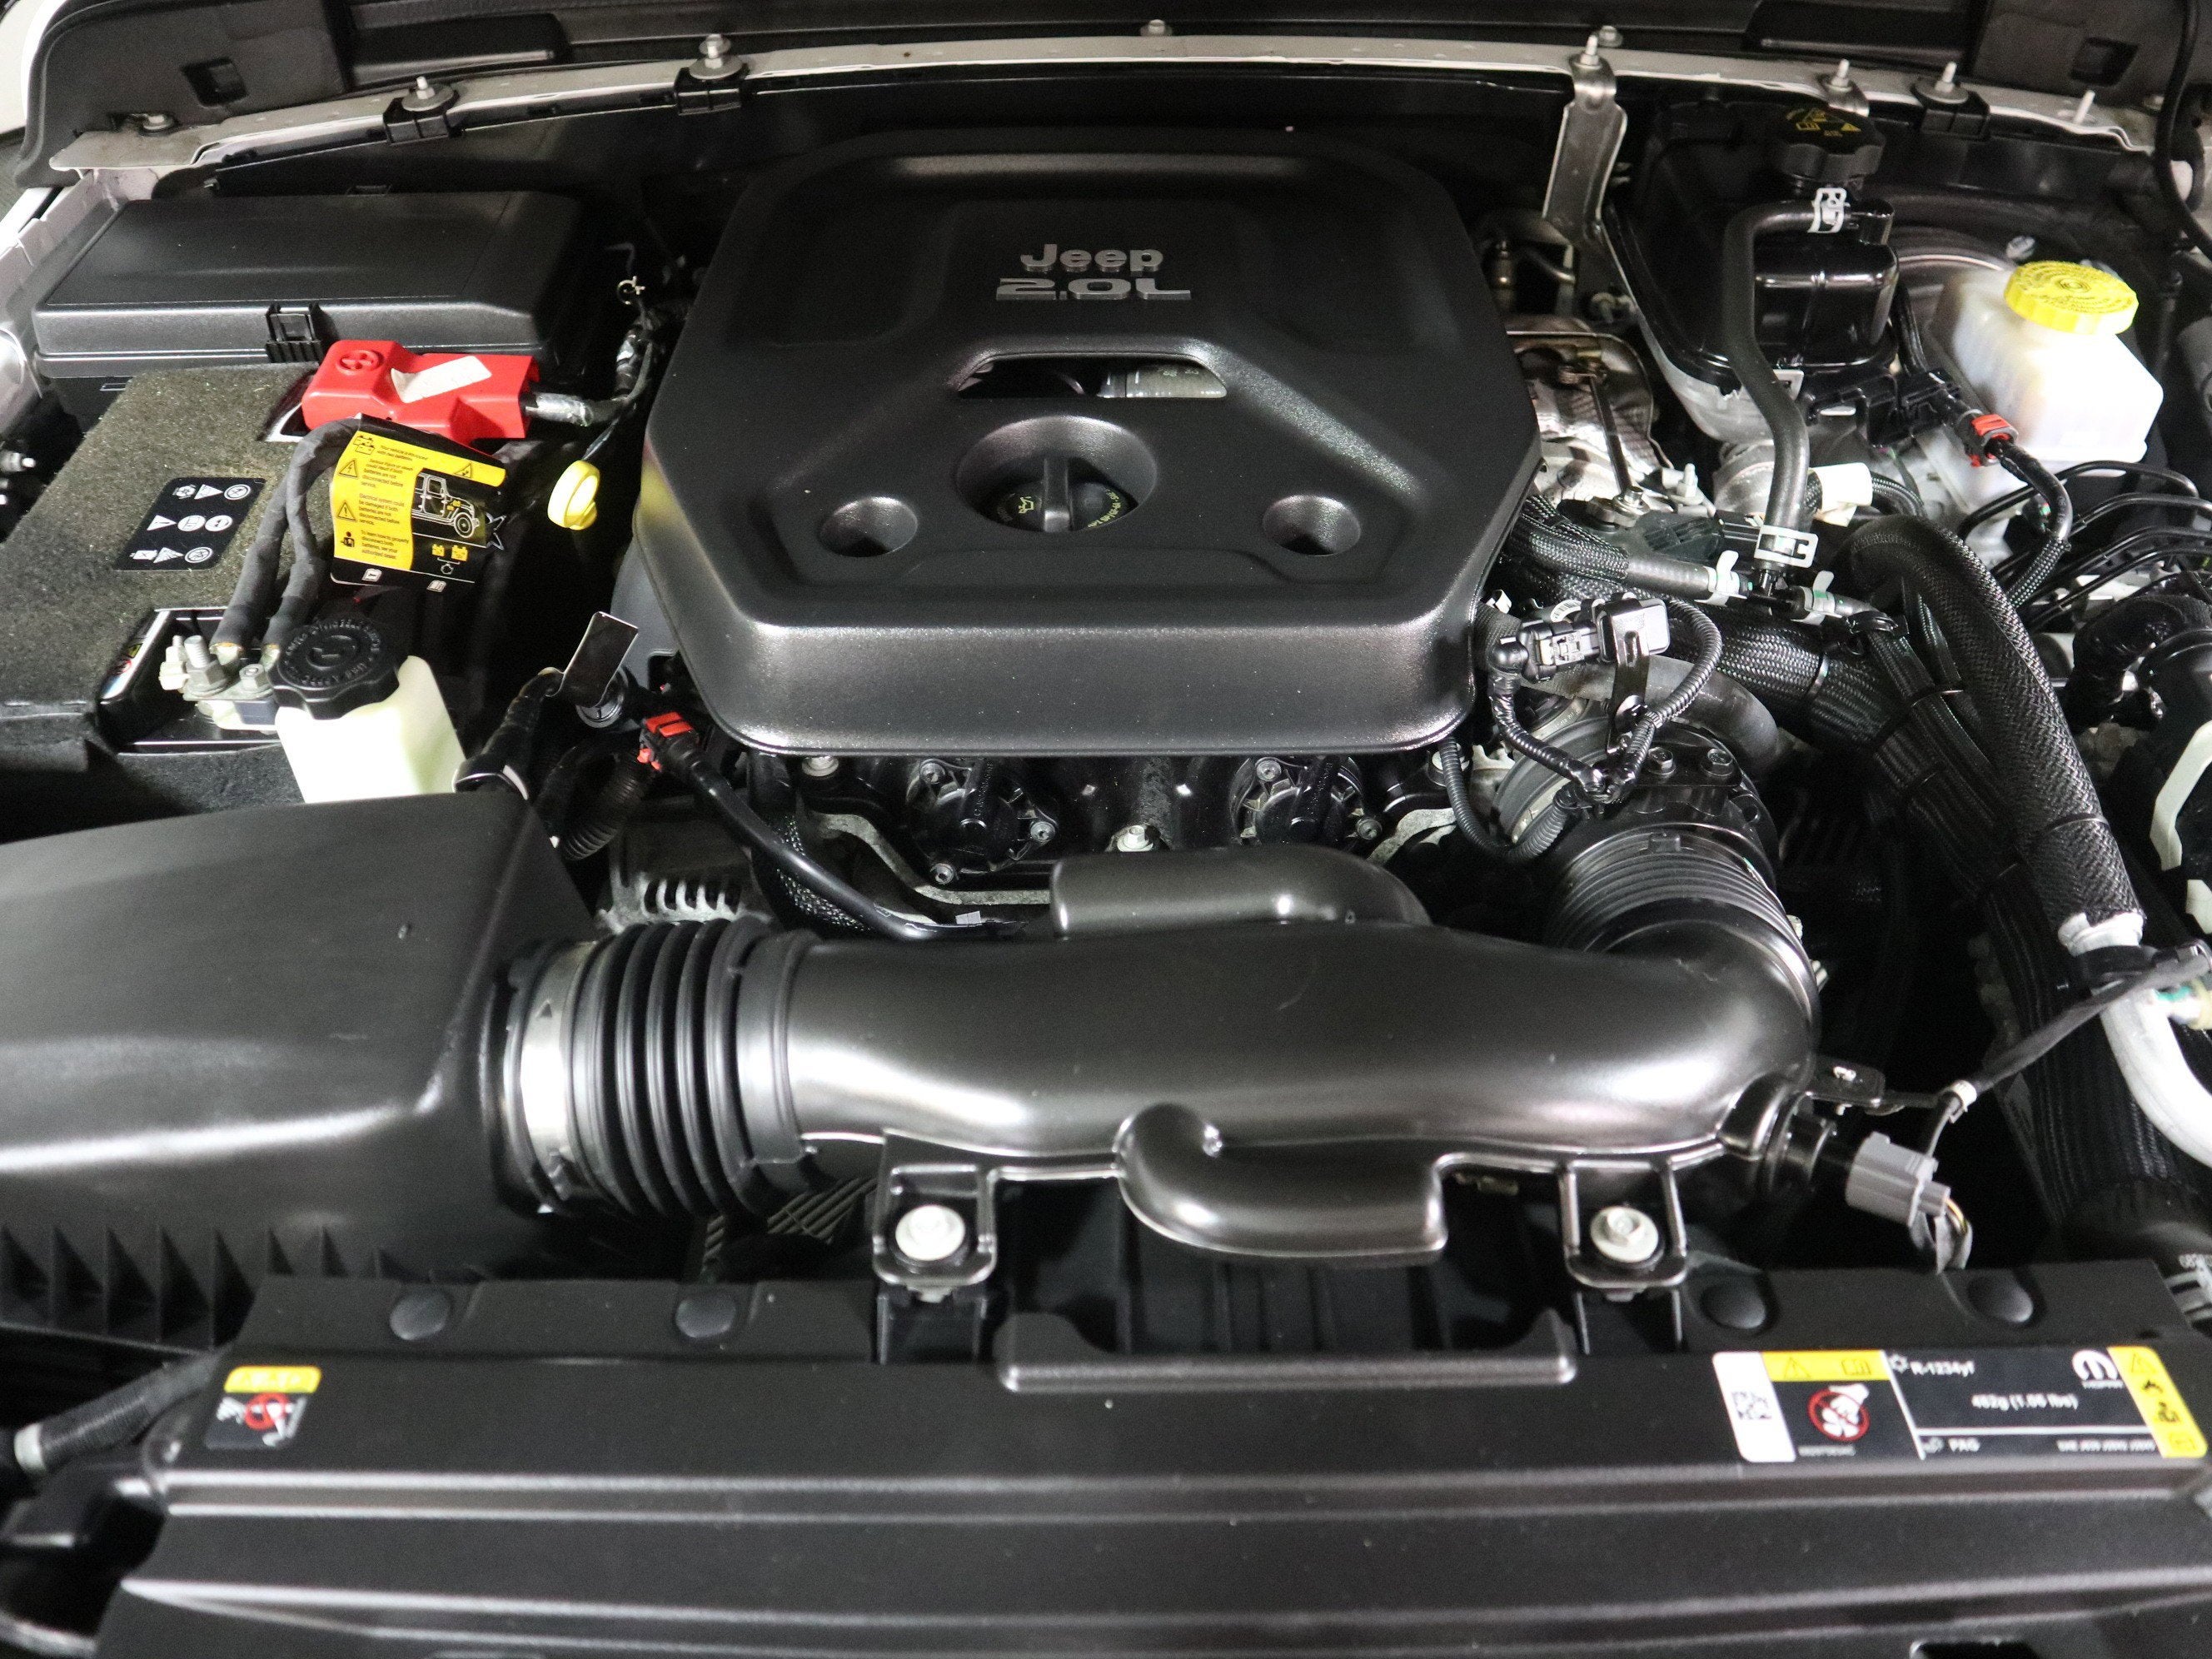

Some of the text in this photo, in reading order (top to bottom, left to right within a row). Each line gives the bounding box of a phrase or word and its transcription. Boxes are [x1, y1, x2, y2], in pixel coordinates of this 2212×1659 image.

[1020, 243, 1163, 276] Jeep
[996, 277, 1193, 301] 2.0L
[1910, 1361, 1975, 1377] R-1234yf
[2047, 1393, 2079, 1410] lbs)
